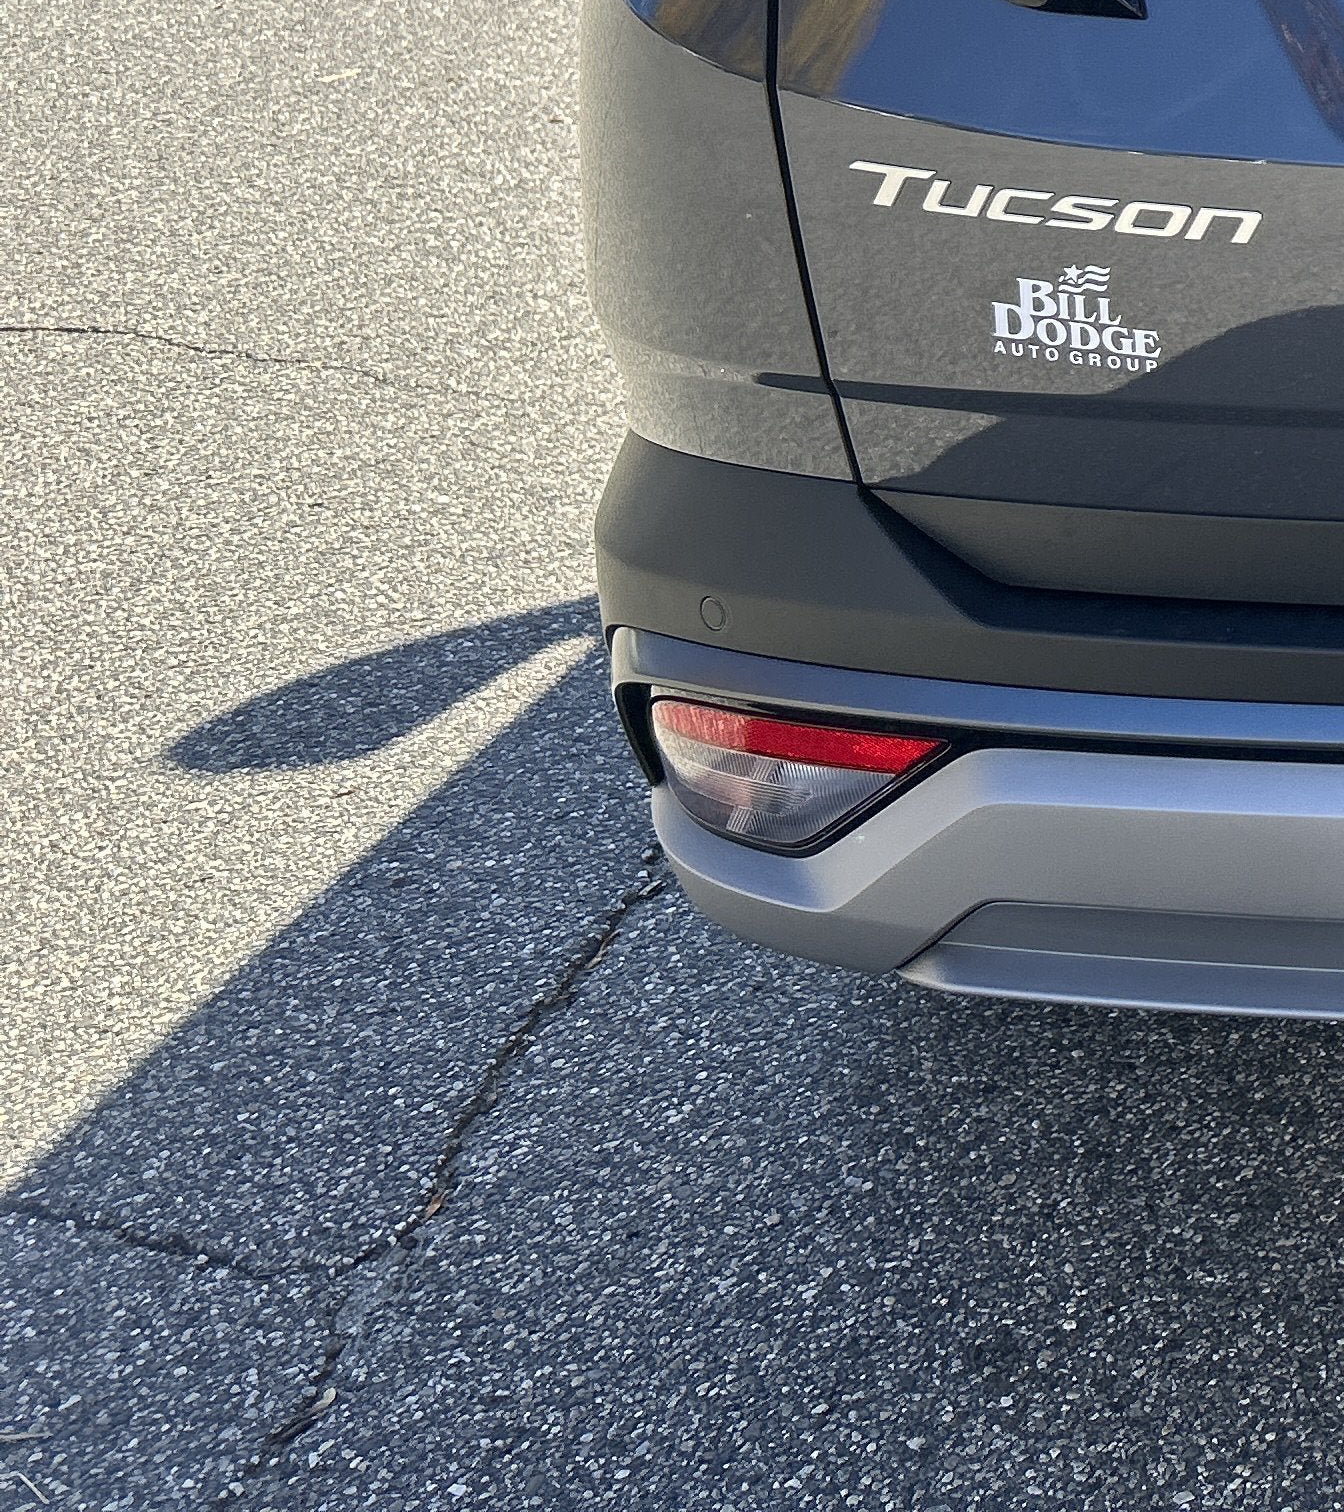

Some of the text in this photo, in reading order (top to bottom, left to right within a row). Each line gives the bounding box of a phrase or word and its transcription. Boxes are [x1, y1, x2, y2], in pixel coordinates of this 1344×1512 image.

[1015, 277, 1122, 326] BILL
[991, 301, 1162, 359] DODGE
[993, 340, 1159, 373] AUTO GROUP
